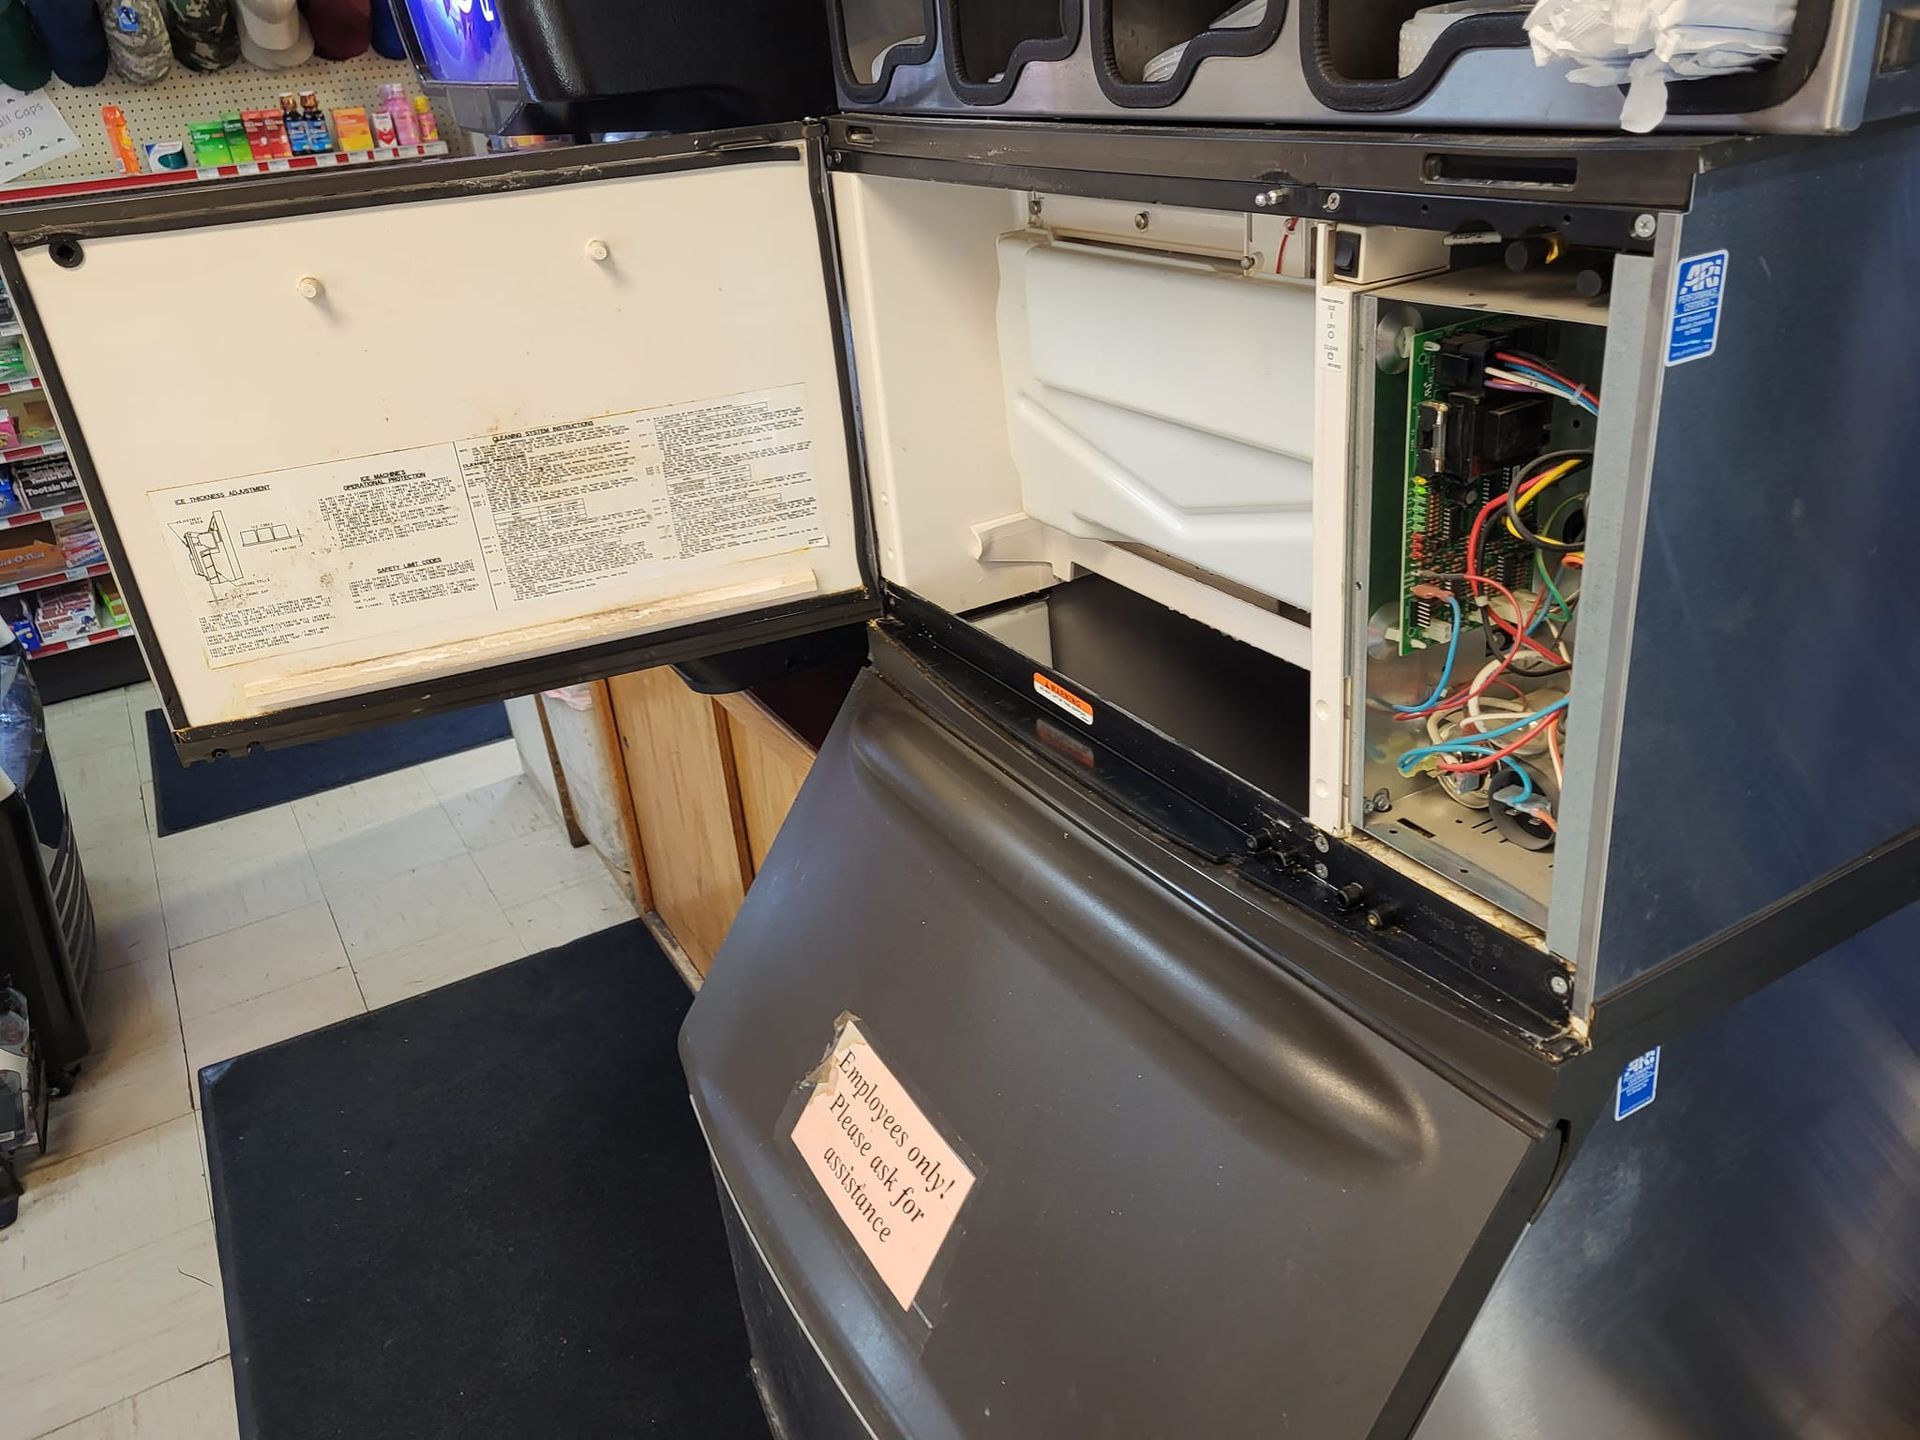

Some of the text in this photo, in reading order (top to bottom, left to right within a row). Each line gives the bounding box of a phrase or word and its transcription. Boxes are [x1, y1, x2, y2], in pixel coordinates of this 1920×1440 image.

[14, 103, 44, 120] Caps
[492, 421, 594, 443] CLEANING SYSTEM INSTRUCTIONS
[343, 472, 426, 491] OPERATIONAL PROTECTION
[360, 475, 372, 483] ICE
[25, 483, 60, 497] Tootsie
[190, 491, 225, 504] THICKNESS
[229, 484, 271, 496] ADJUSTMENT
[377, 557, 442, 574] SAFETY LIMIT CODES
[835, 1050, 955, 1200] Employees only!
[829, 1092, 924, 1223] Please ask for
[823, 1146, 892, 1243] assistance
